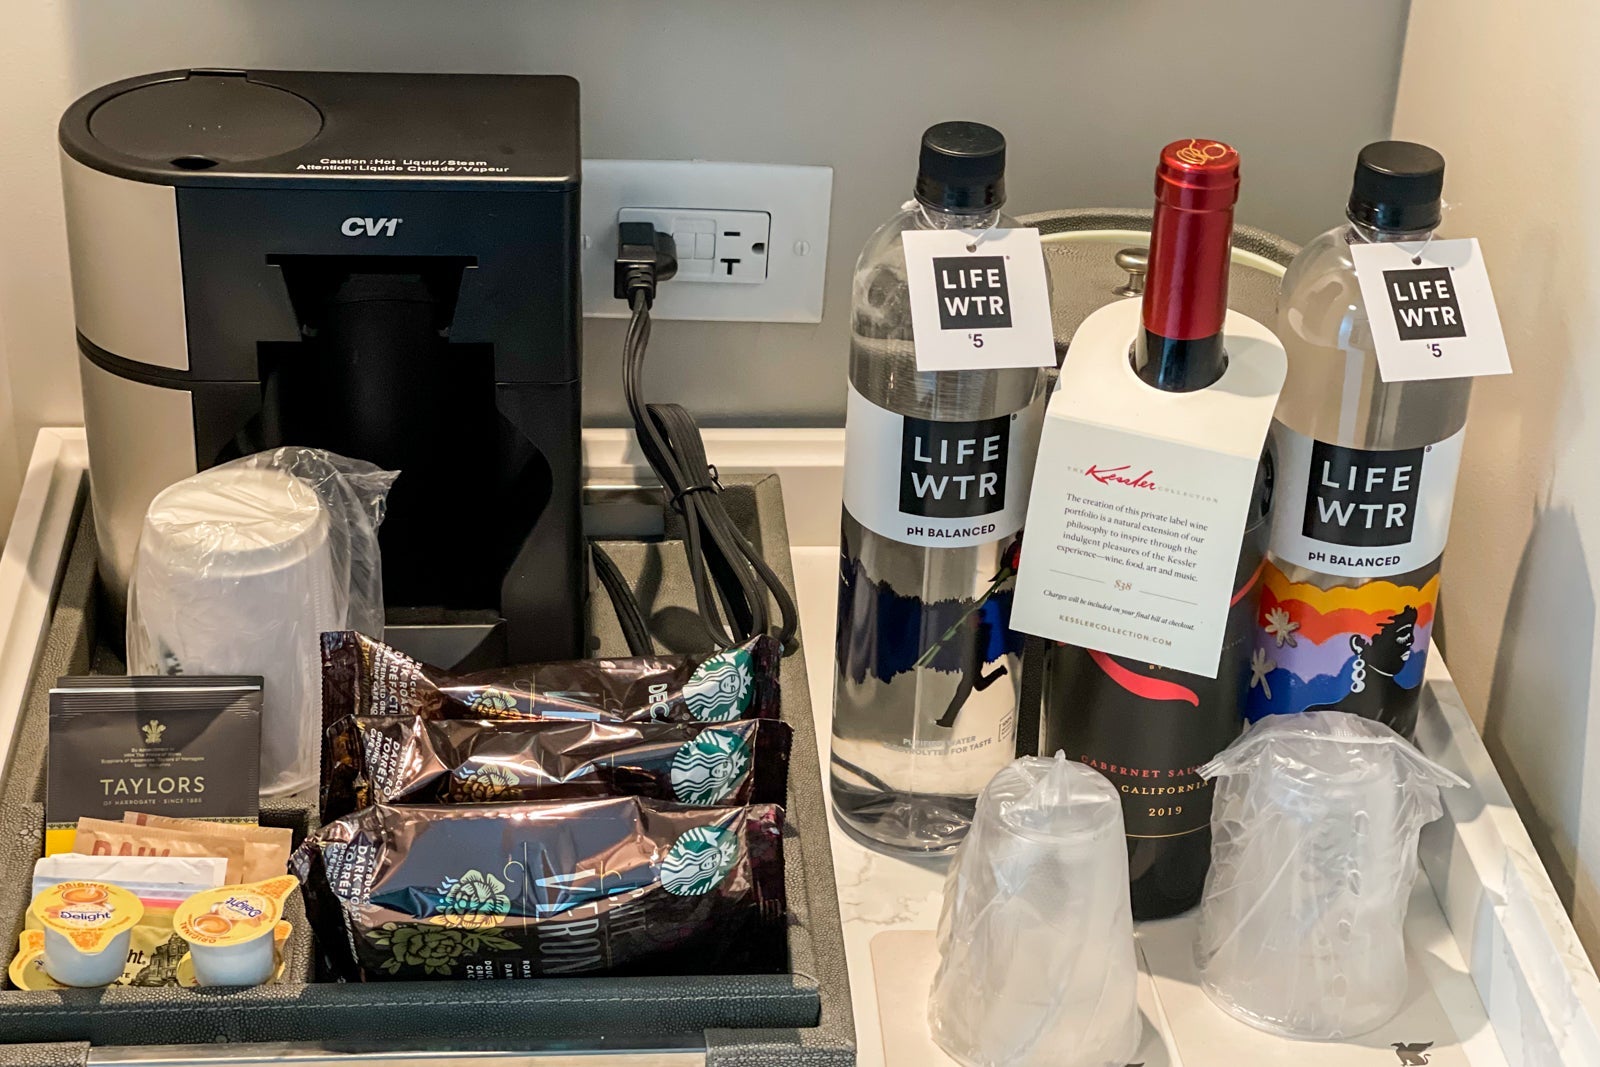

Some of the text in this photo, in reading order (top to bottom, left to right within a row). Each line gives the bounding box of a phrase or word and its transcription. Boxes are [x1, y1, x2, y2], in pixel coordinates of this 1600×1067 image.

[403, 159, 487, 167] Liquid/Steam
[341, 217, 399, 237] CV1
[942, 269, 1001, 289] LIFE
[1393, 280, 1450, 301] LIFE
[944, 296, 1004, 316] WTR
[1399, 306, 1457, 327] WTR
[914, 435, 1000, 465] LIFE
[911, 472, 998, 500] WTR
[1085, 464, 1157, 491] Kessler
[1321, 460, 1412, 492] LIFE
[1067, 493, 1208, 532] The creation of this private label wine
[1317, 496, 1407, 529] WTR
[907, 523, 996, 538] pH BALANCED
[1064, 506, 1098, 521] portfolio
[1099, 512, 1106, 522] is
[1113, 517, 1141, 530] natural
[1142, 524, 1179, 539] extension
[1180, 530, 1190, 540] of
[1190, 535, 1205, 544] our
[1066, 519, 1198, 556] philosophy to inspire through the
[1063, 532, 1197, 569] indulgent pleasures of the Kessler
[1308, 552, 1401, 567] pH BALANCED
[1125, 558, 1145, 571] food,
[1146, 564, 1157, 573] art
[1158, 566, 1173, 577] and
[1174, 571, 1198, 583] music.
[1114, 579, 1133, 591] $38
[1043, 589, 1068, 601] Charges
[1079, 596, 1086, 605] be
[1087, 598, 1113, 611] included
[1120, 607, 1135, 618] your
[1134, 611, 1150, 620] final
[1150, 613, 1161, 623] bill
[1161, 617, 1168, 625] at
[1168, 618, 1195, 631] checkout.
[1059, 614, 1173, 647] KESSLERCOLLECTION.COM
[399, 681, 410, 715] ROAS
[970, 738, 992, 751] TASTE
[388, 741, 401, 776] DARK
[1081, 754, 1203, 779] CABERNET SAU
[100, 776, 205, 795] TAYLORS
[1121, 780, 1209, 795] CALIFORNIA
[1148, 806, 1183, 817] 2019
[350, 845, 368, 923] DARK ROAST
[363, 847, 377, 905] STARBUCKS
[60, 911, 111, 922] Delight
[224, 897, 262, 918] Delight
[535, 868, 602, 975] VERON
[466, 965, 476, 980] CAC
[484, 960, 494, 980] DOUC
[504, 963, 513, 980] DAR
[522, 960, 532, 980] ROAS
